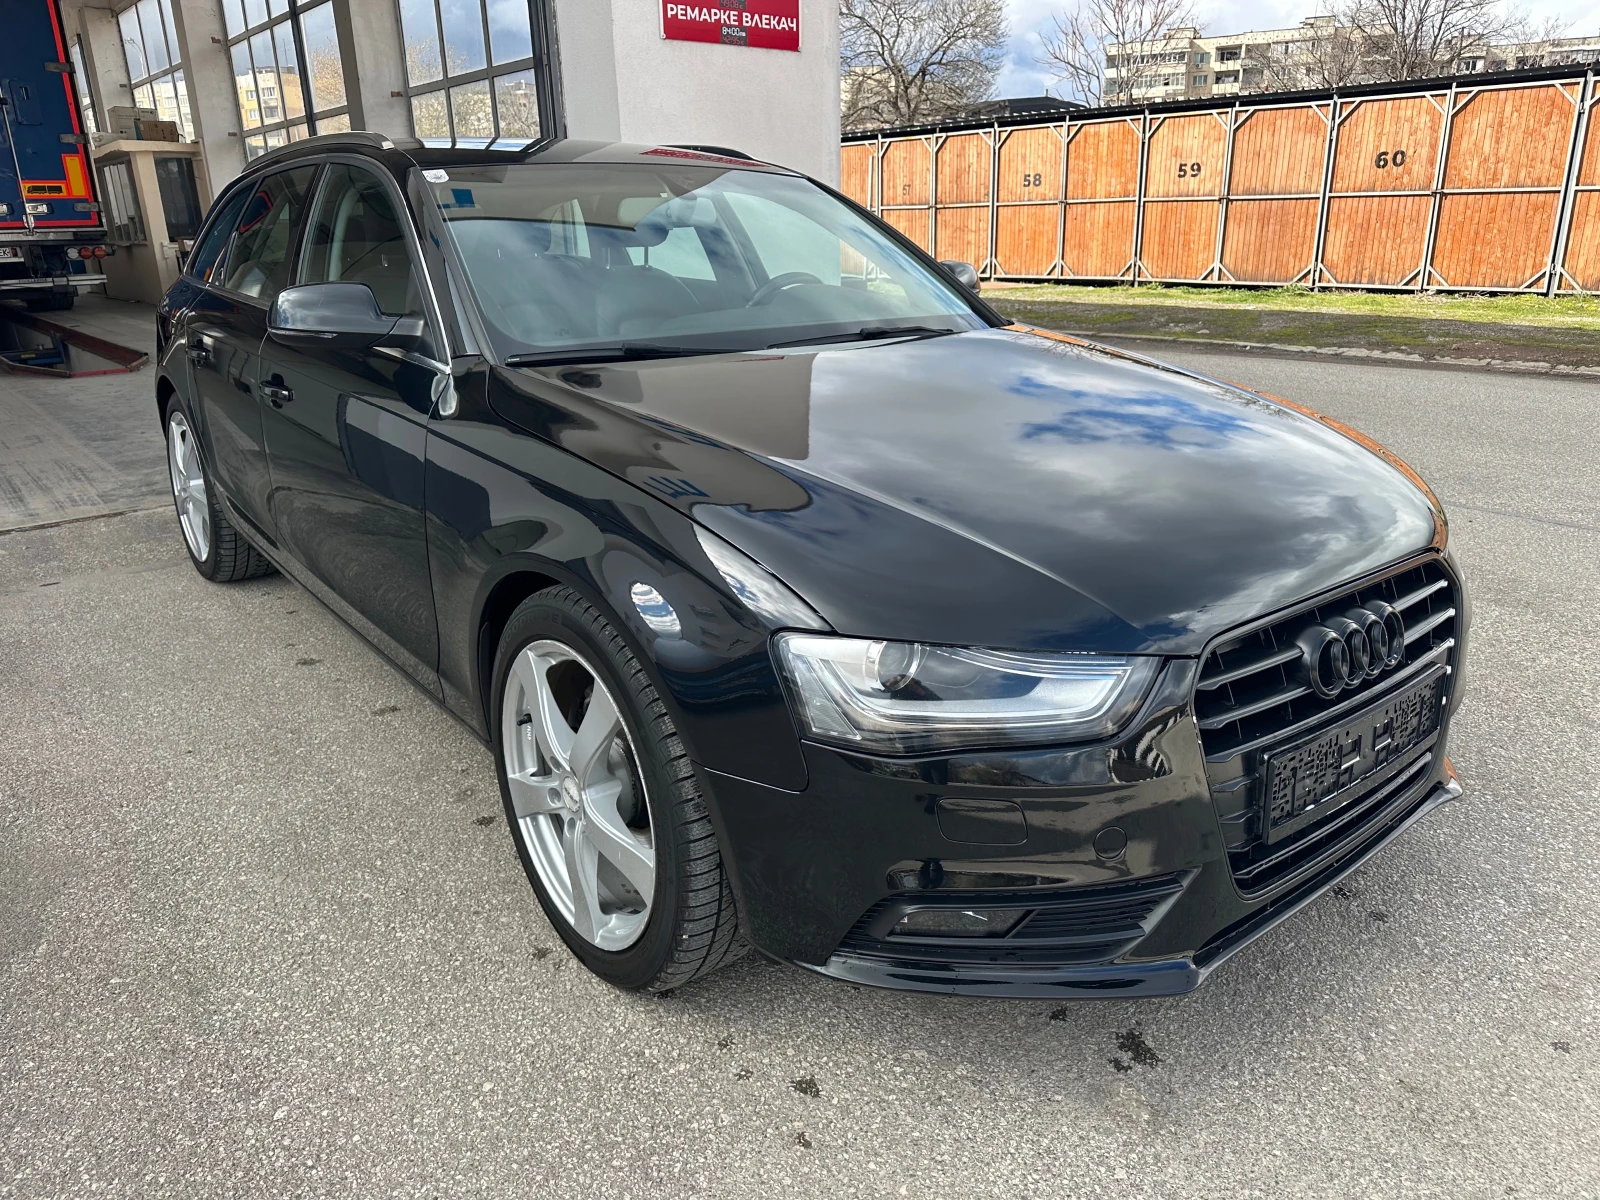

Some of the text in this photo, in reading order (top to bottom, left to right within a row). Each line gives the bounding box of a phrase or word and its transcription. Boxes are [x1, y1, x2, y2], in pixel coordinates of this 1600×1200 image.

[667, 3, 797, 31] РЕМАРКЕ ВЛЕКАЧ
[1374, 149, 1406, 169] 60
[1177, 161, 1202, 179] 59
[1022, 172, 1042, 188] 58
[902, 184, 911, 196] 57
